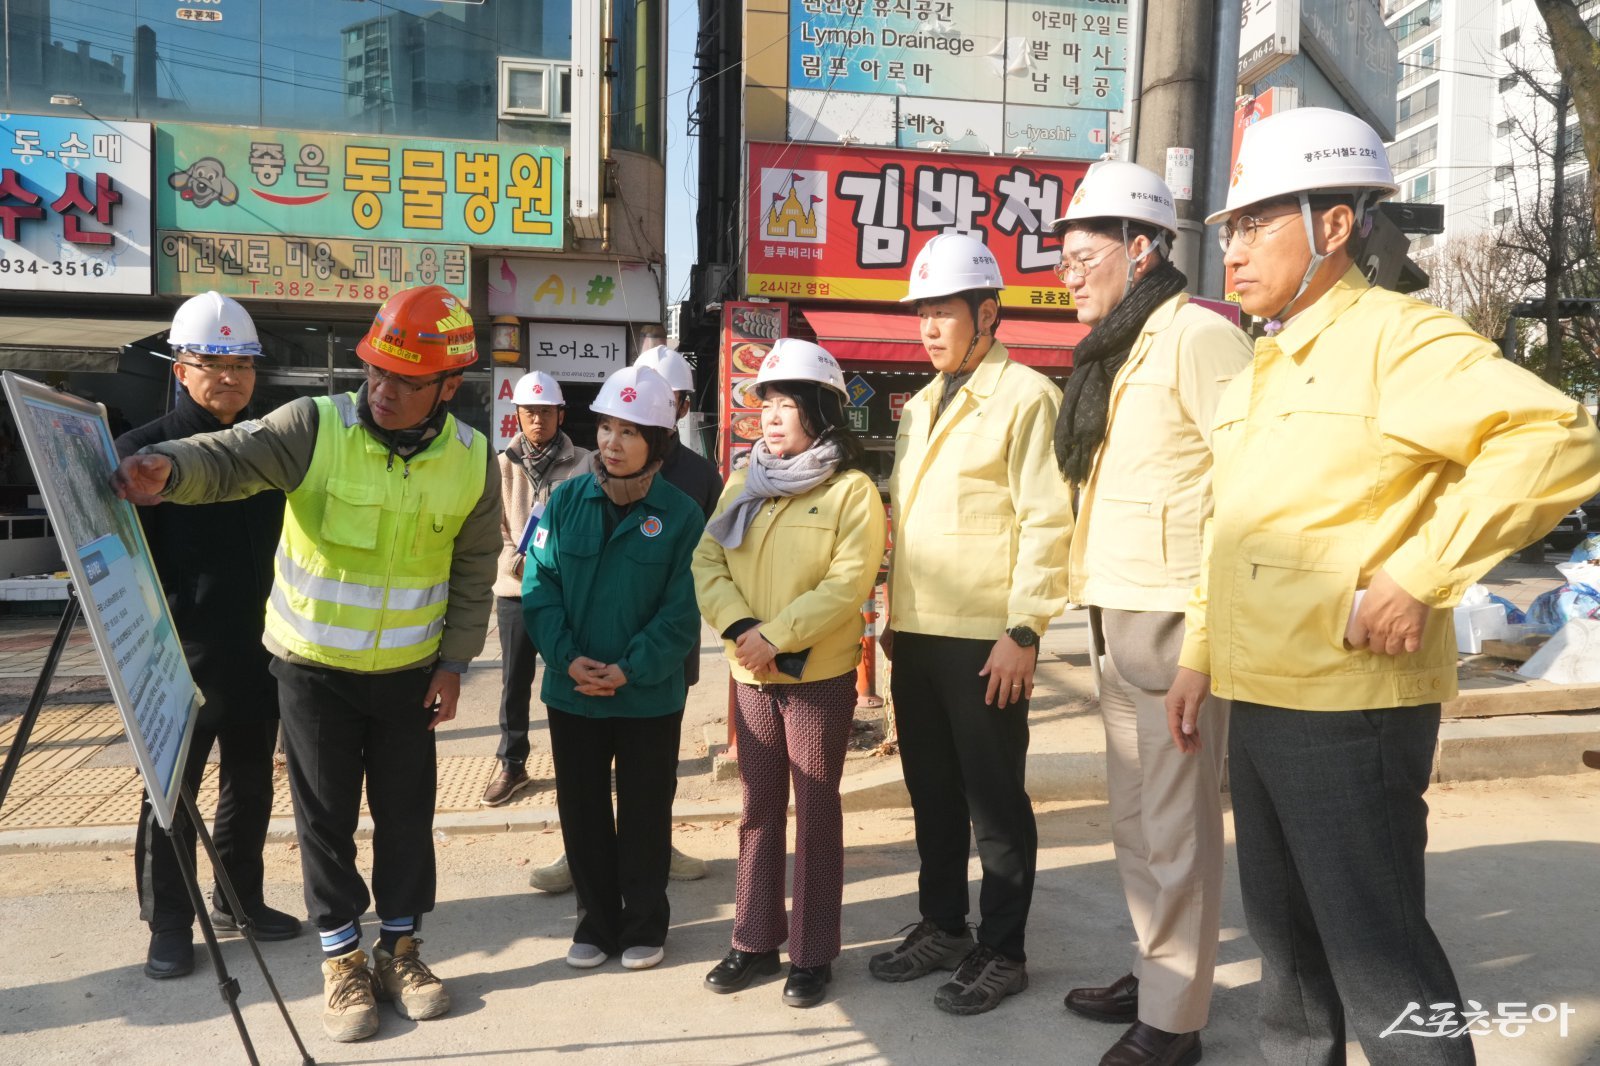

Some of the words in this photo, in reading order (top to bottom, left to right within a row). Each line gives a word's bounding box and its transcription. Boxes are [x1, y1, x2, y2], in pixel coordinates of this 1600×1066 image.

[1032, 10, 1078, 33] 아로마
[1081, 14, 1110, 36] 오일
[802, 22, 875, 48] Lymph
[882, 28, 975, 56] Drainage
[802, 56, 848, 77] 림프
[860, 60, 933, 84] 아로마
[1304, 147, 1357, 162] 광주도시철도
[248, 141, 330, 188] 좋은
[343, 144, 553, 236] 동물병원
[764, 245, 824, 260] 블루베리네
[0, 258, 105, 277] 934-3516
[248, 280, 389, 300] T.382-7588
[760, 280, 802, 294] 24시간
[806, 282, 830, 295] 영업
[1030, 289, 1071, 306] 금호점
[536, 341, 620, 361] 모어요가
